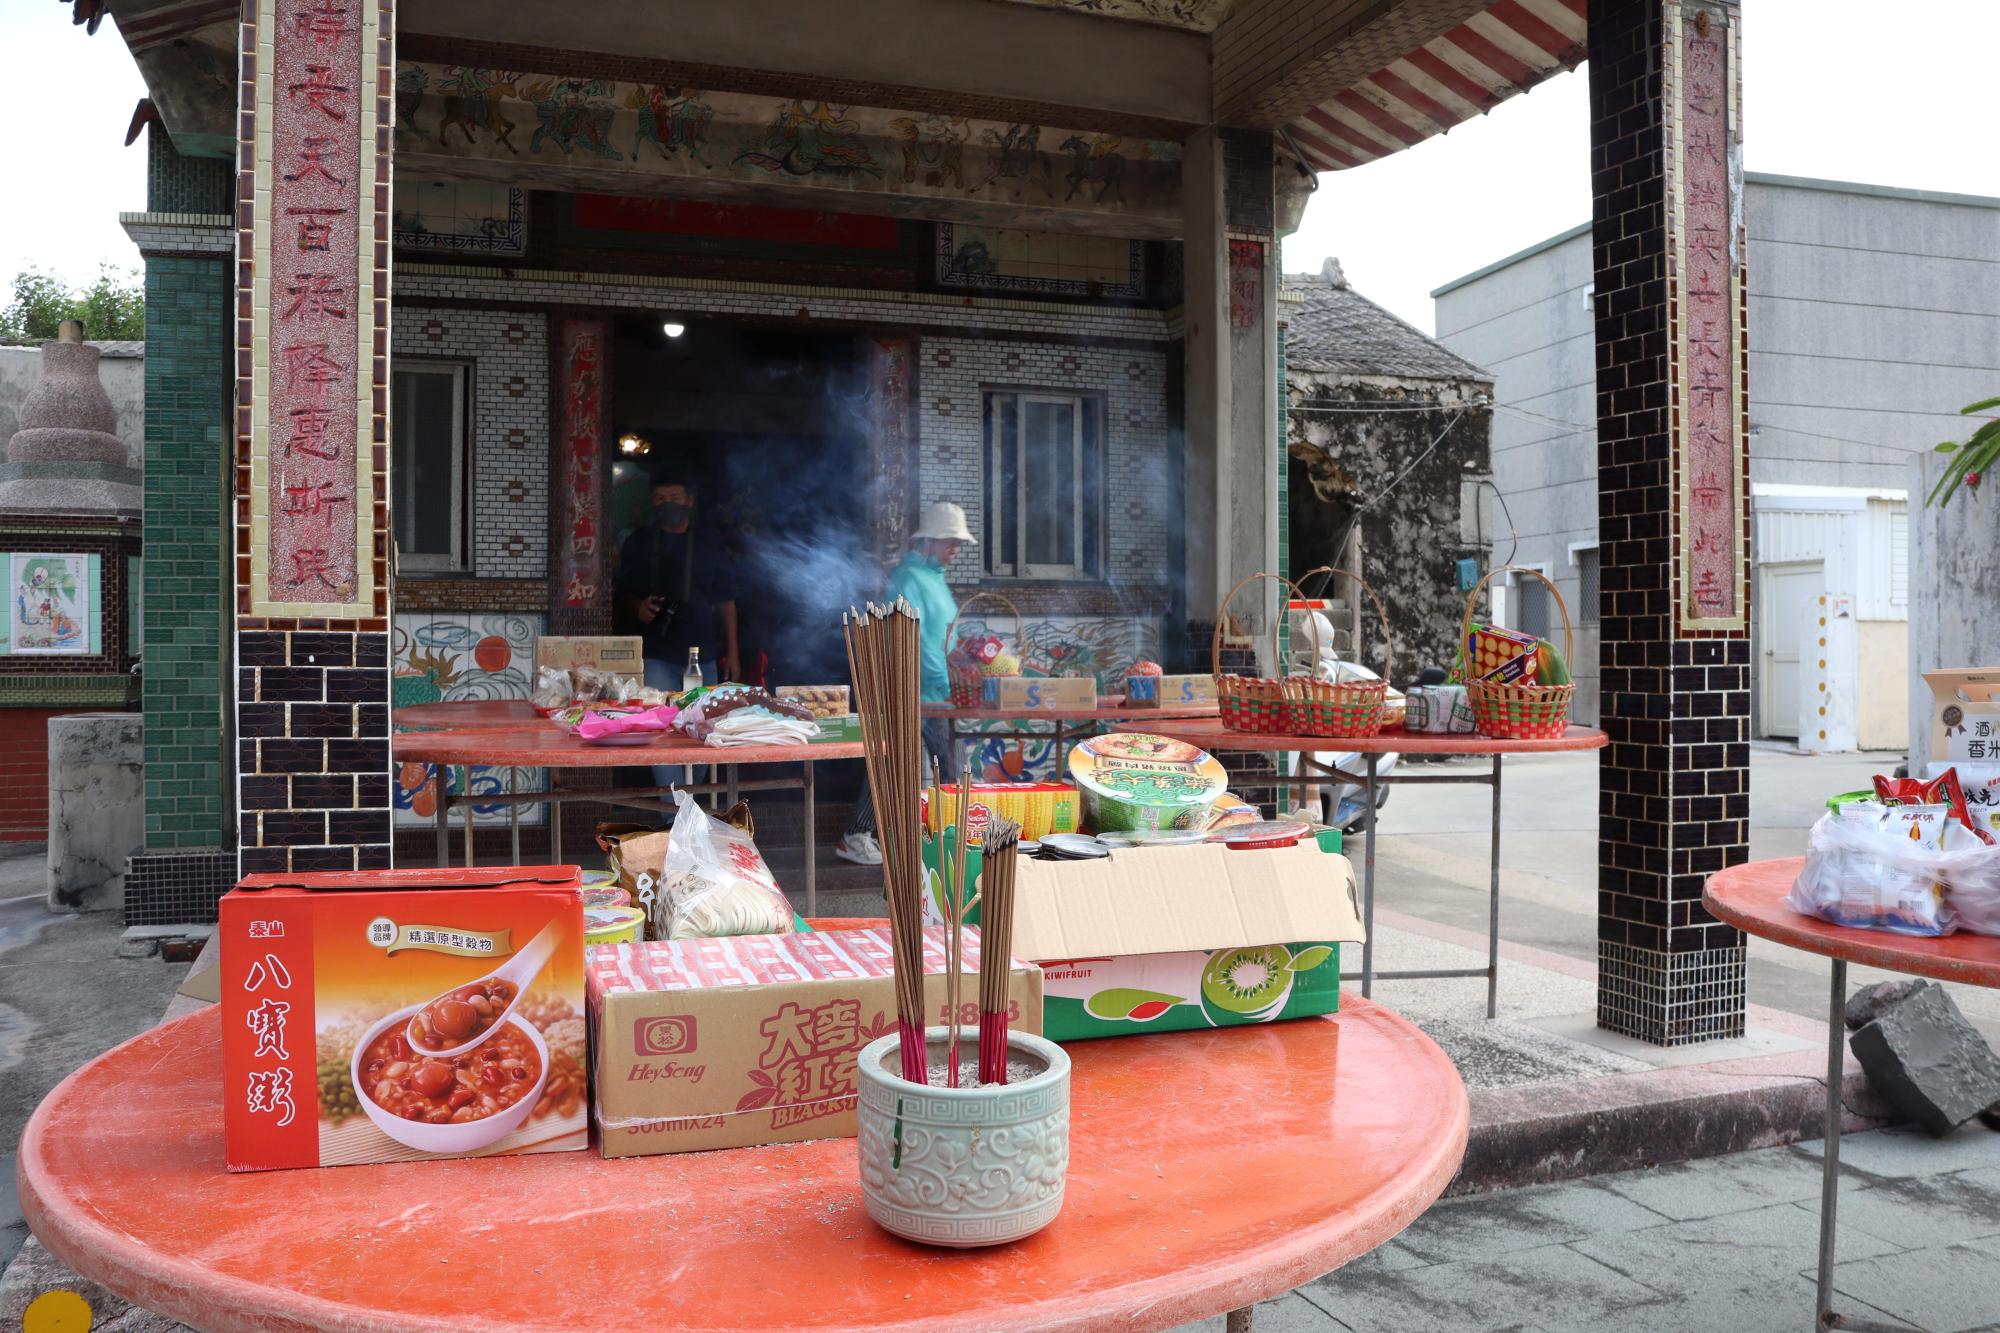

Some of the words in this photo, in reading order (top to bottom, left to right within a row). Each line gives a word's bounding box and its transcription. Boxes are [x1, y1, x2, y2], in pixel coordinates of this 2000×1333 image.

[249, 920, 285, 938] 泰山
[373, 924, 391, 933] 領導
[373, 933, 391, 942] 品牌
[408, 930, 493, 951] 精選原型穀物
[1044, 969, 1093, 981] KIWIFRUIT
[244, 953, 296, 1127] 八寶粥
[657, 1025, 675, 1046] 黑松
[759, 998, 862, 1070] 大麥
[771, 1094, 844, 1131] BLACK
